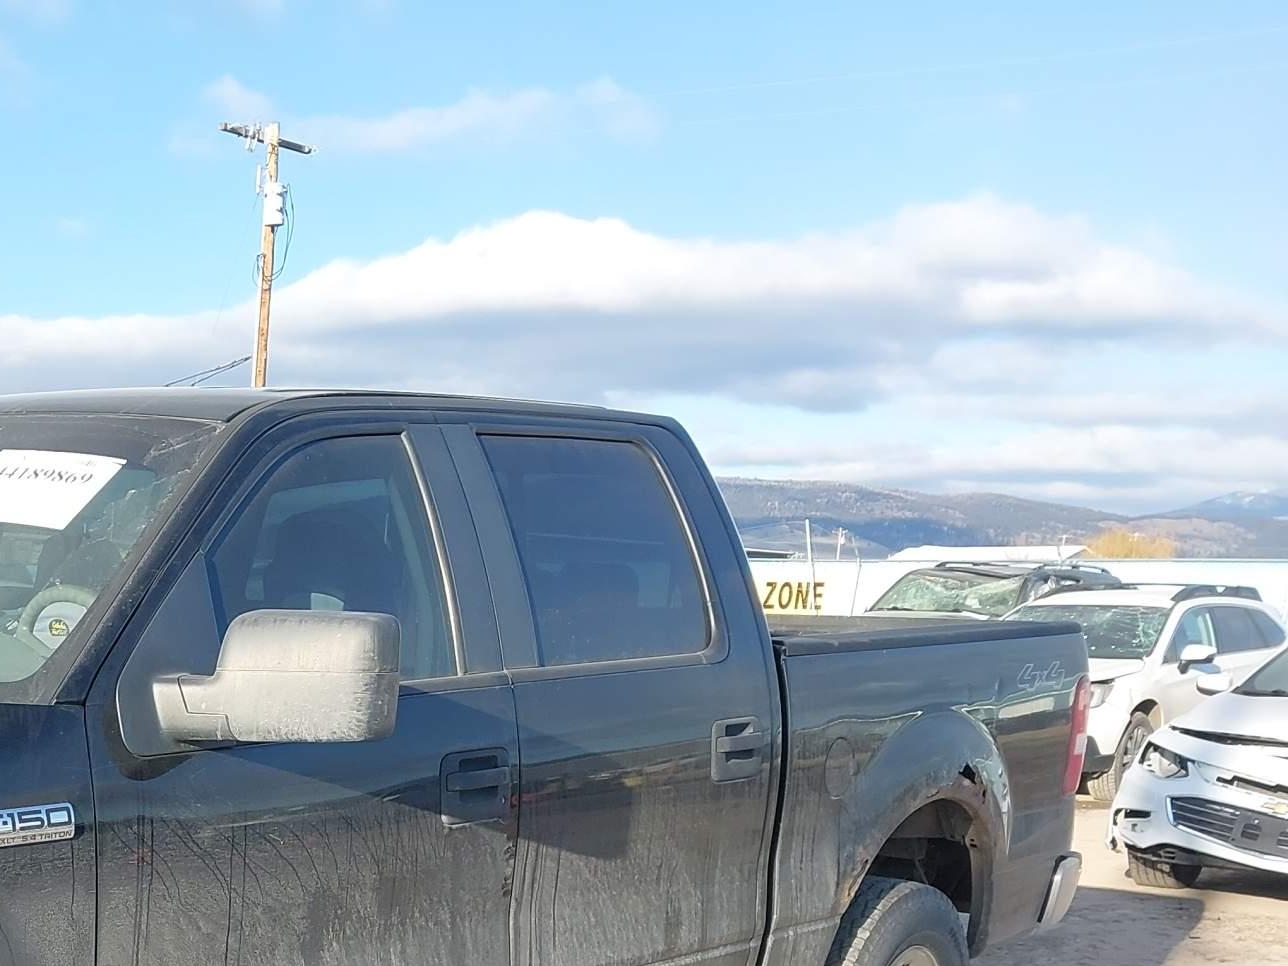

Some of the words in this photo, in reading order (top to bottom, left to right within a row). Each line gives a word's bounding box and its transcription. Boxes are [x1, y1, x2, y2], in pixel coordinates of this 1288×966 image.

[763, 581, 825, 610] ZONE
[1016, 660, 1065, 691] 4x4
[0, 836, 17, 846] XLT
[39, 831, 73, 841] TRITON
